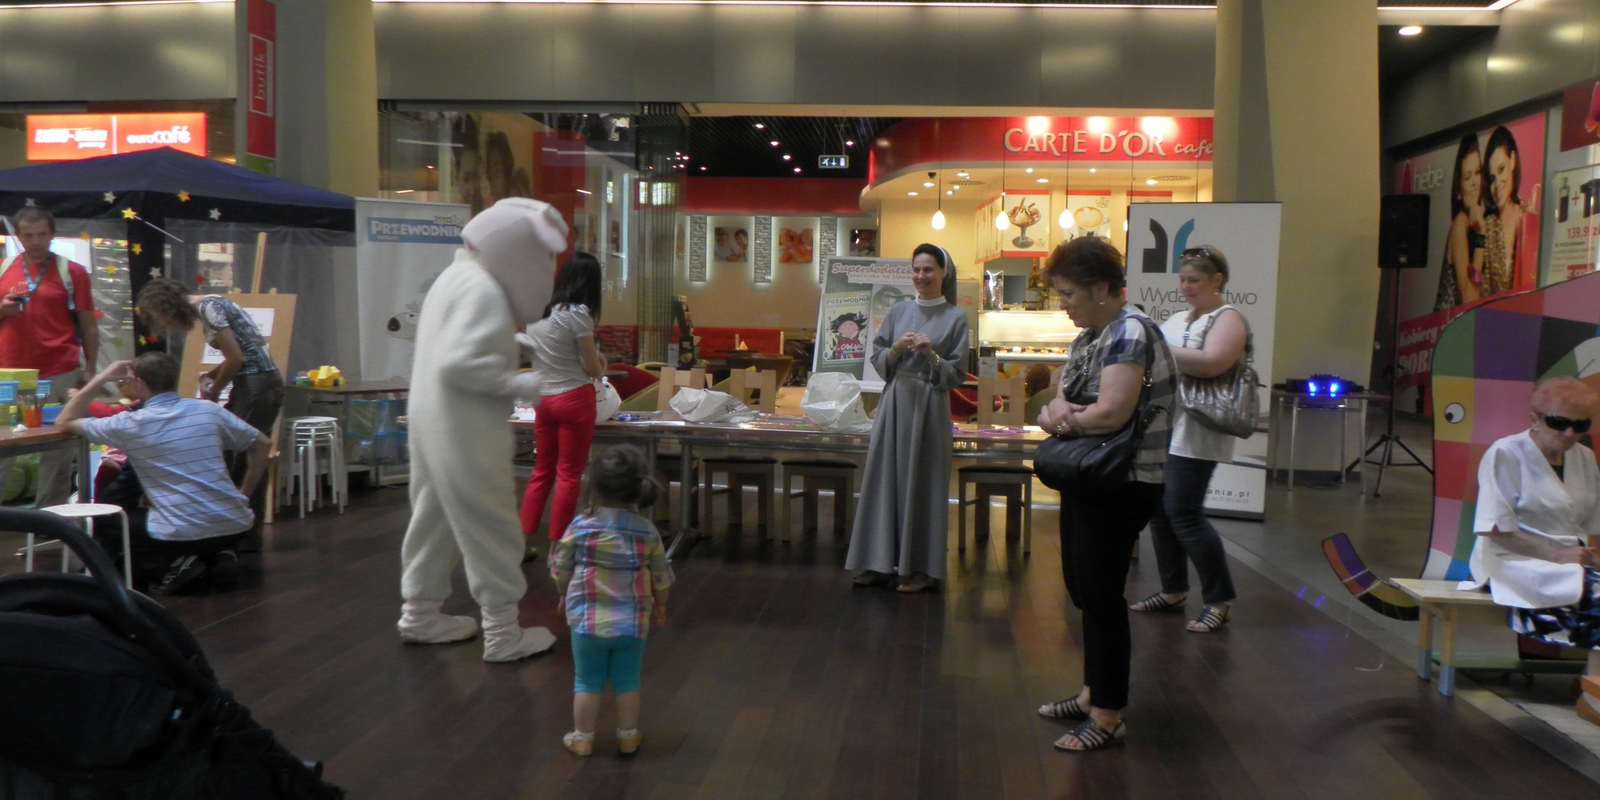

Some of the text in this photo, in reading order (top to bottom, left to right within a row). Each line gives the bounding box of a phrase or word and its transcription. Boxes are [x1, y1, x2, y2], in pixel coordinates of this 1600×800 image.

[254, 53, 266, 100] butik
[1004, 127, 1088, 157] CARTE
[1173, 139, 1213, 158] cafe
[1413, 164, 1443, 191] hebe
[371, 220, 462, 237] PRZEWODNIK
[831, 263, 914, 275] Superdodatek
